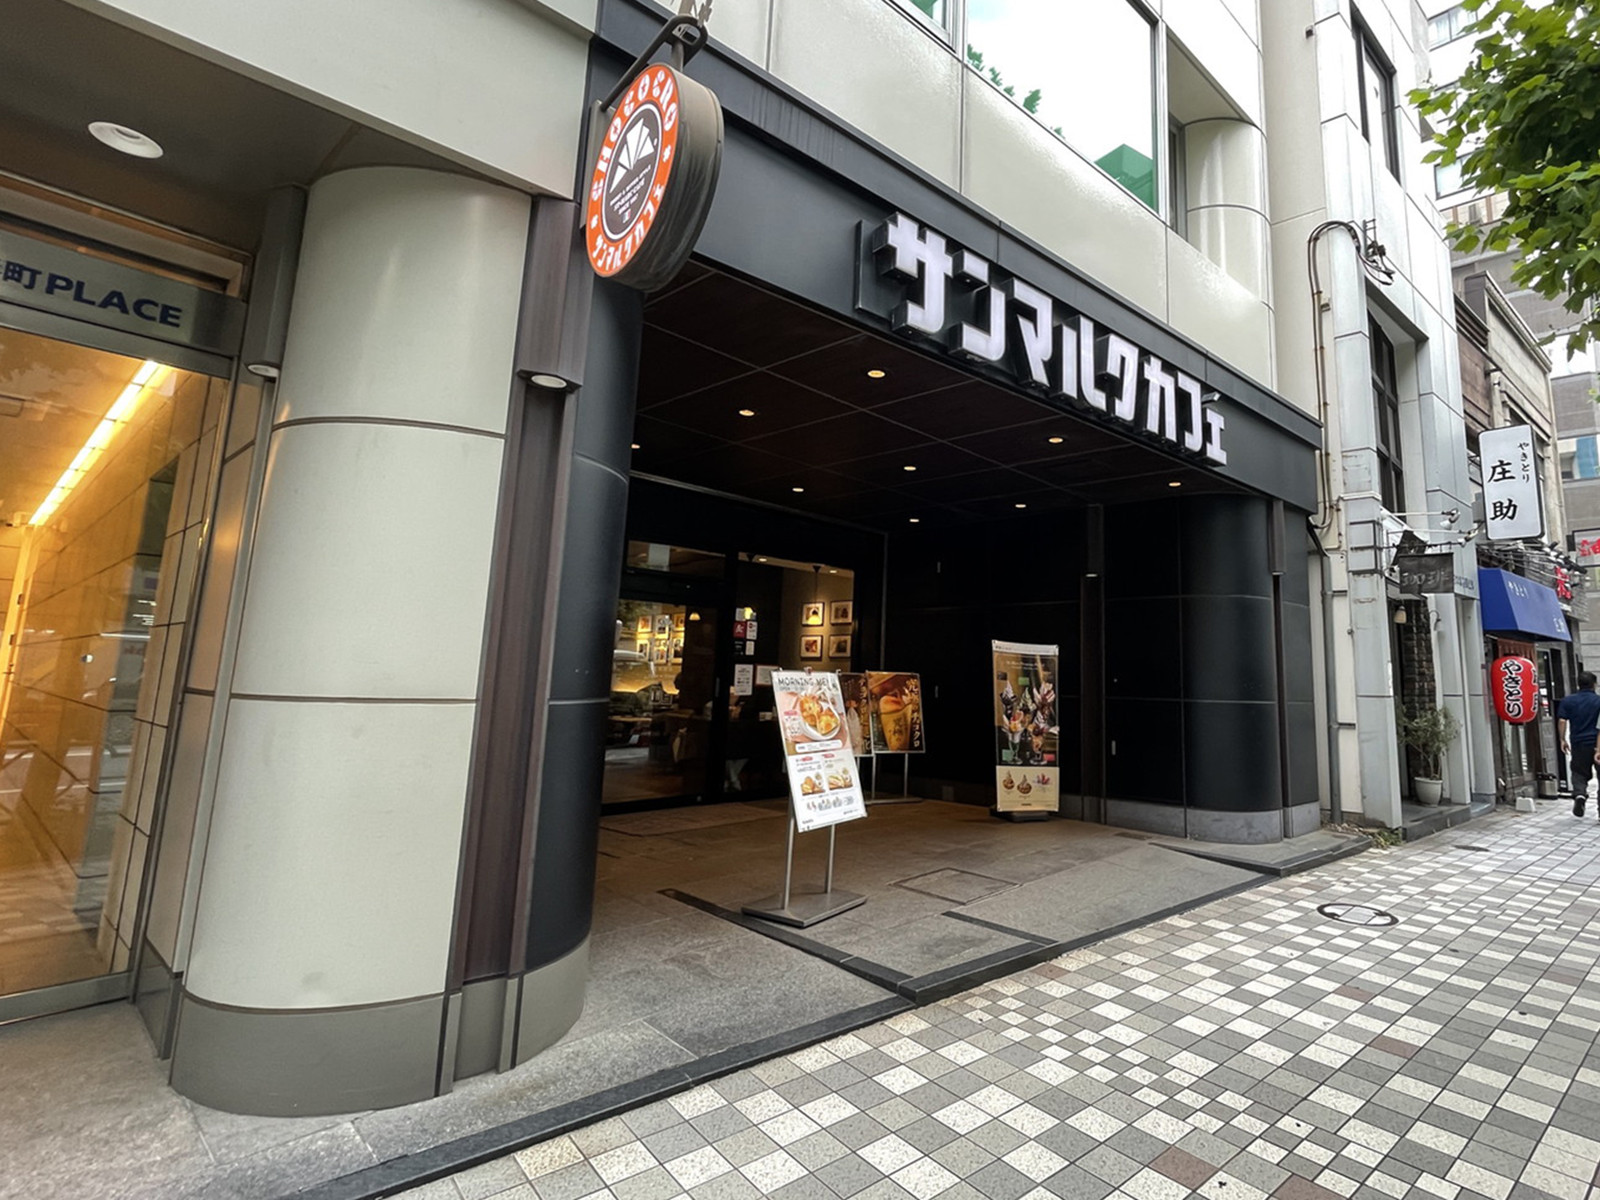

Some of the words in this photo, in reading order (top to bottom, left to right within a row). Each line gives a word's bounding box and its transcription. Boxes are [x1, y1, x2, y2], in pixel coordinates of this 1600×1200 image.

[592, 184, 664, 271] サンマルクカフェ
[0, 260, 42, 290] 町
[45, 272, 183, 328] PLACE
[886, 211, 1228, 466] サンマルクカフェ
[1487, 460, 1518, 522] 庄助
[1516, 441, 1531, 484] やきとり
[778, 677, 813, 686] MORNING
[1501, 659, 1523, 718] やきとり
